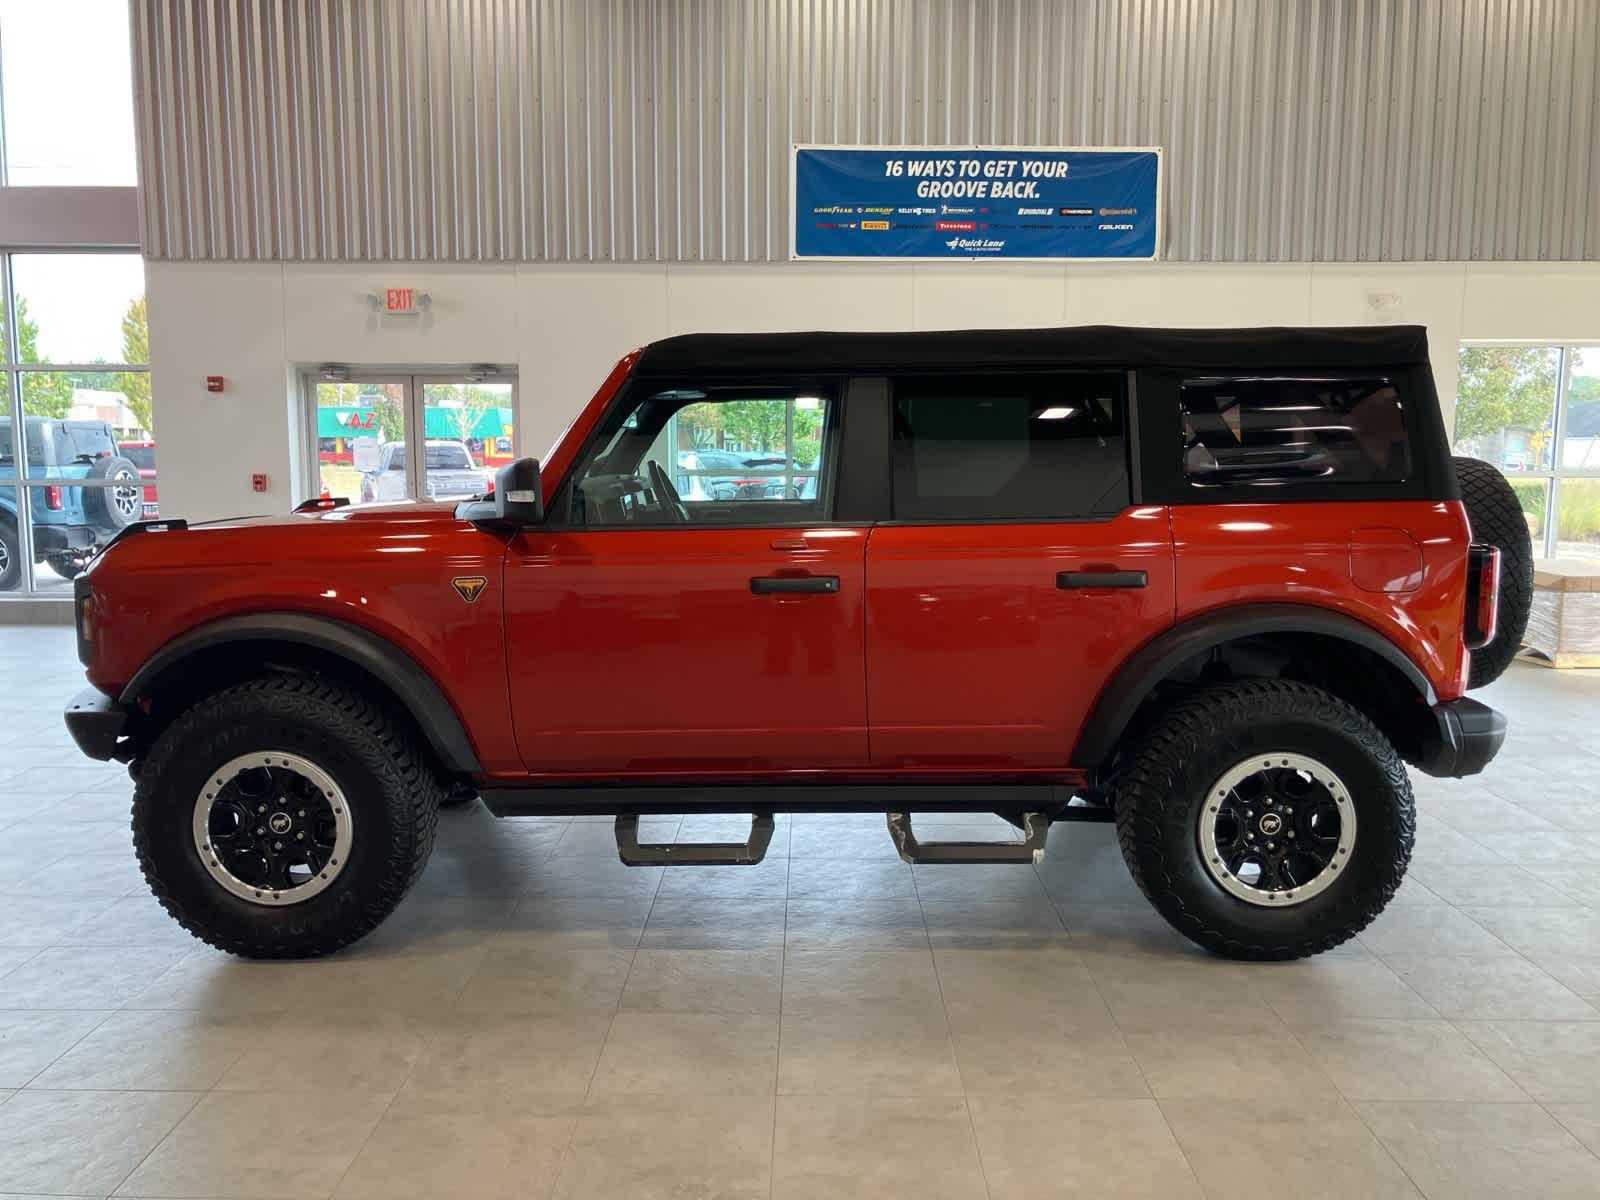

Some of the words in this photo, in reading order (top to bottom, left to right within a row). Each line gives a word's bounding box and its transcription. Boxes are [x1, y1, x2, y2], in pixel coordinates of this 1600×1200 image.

[885, 160, 903, 177] 16
[907, 160, 955, 177] WAYS
[959, 160, 980, 177] TO
[983, 160, 1018, 178] GET
[1021, 161, 1069, 178] YOUR
[916, 180, 988, 198] GROOVE
[990, 181, 1041, 199] BACK.
[959, 239, 983, 248] Quick
[983, 239, 1005, 247] Lane
[387, 288, 413, 310] EXIT
